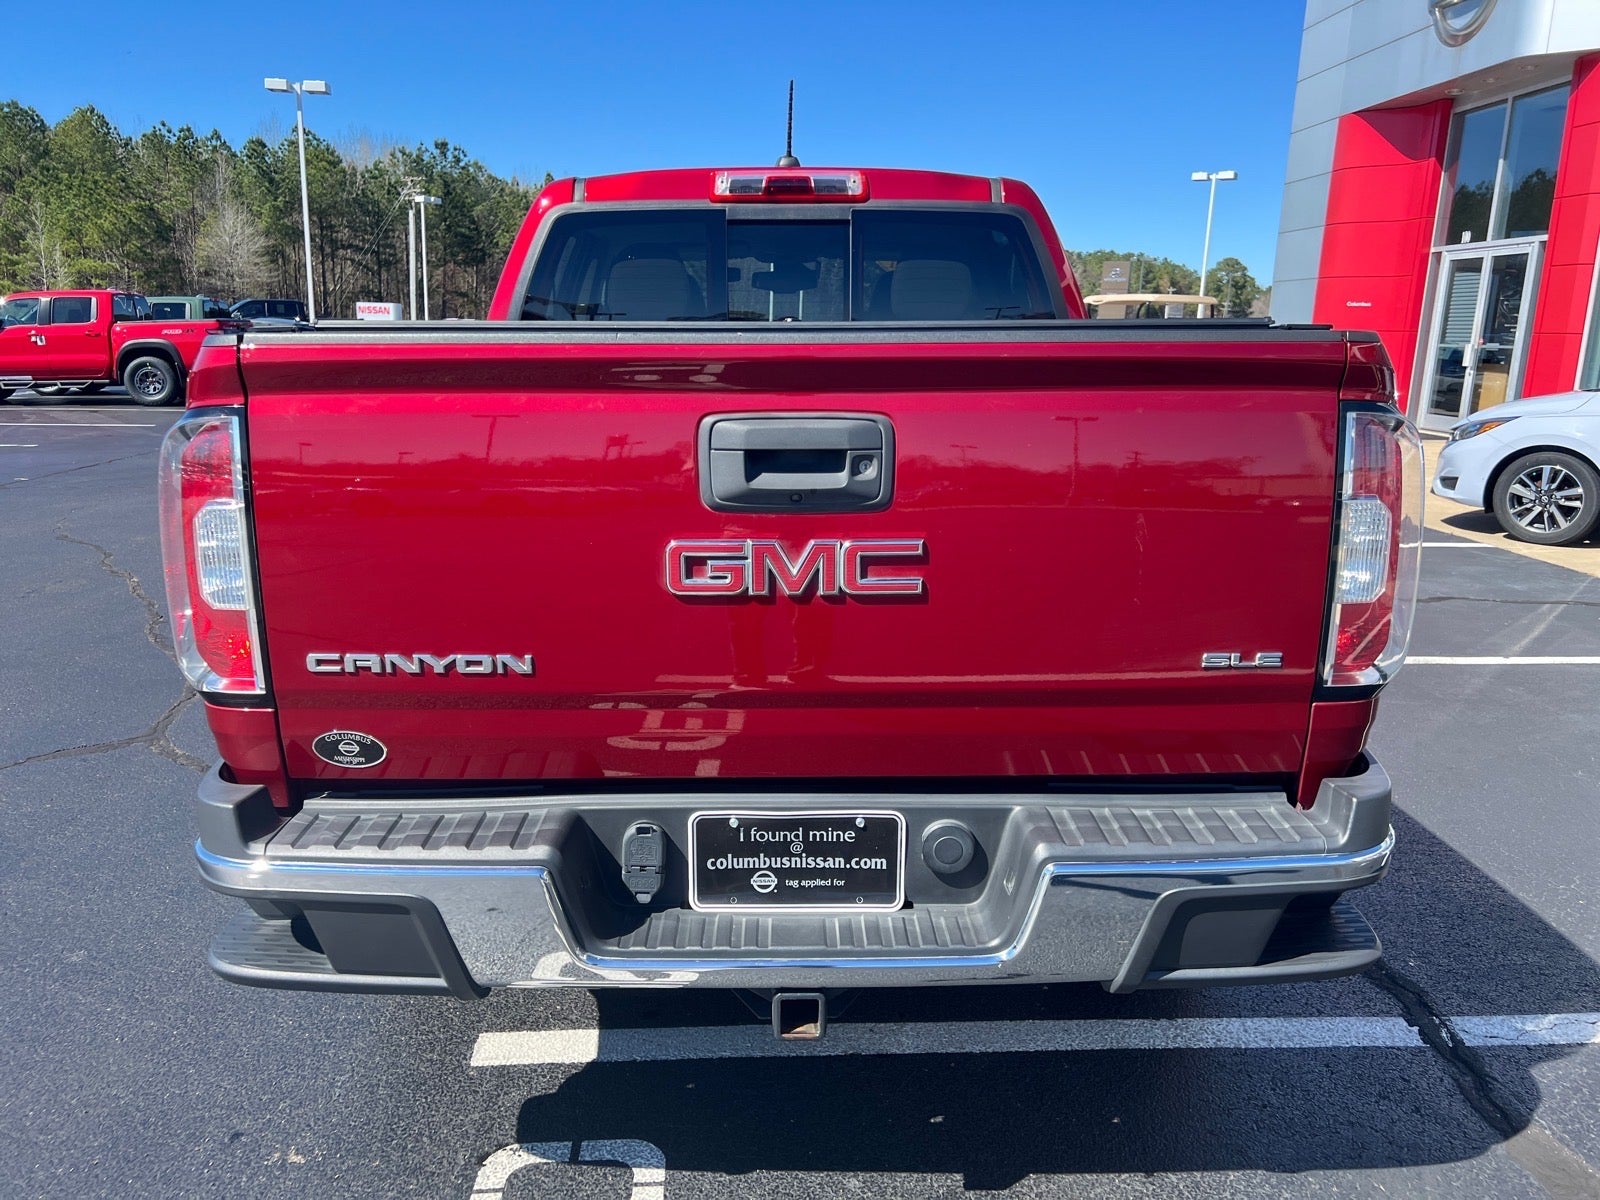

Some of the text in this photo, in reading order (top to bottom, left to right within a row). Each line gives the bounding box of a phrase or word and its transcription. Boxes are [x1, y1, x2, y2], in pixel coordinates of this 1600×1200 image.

[358, 305, 390, 315] NISSAN
[665, 539, 924, 595] GMC
[306, 653, 533, 674] CANYON
[1201, 652, 1283, 668] SLE
[324, 733, 372, 745] COLUMBUS
[750, 826, 803, 842] found
[809, 827, 856, 842] mine
[790, 842, 804, 854] @
[706, 853, 887, 870] columbusnissan.com
[785, 878, 845, 888] tag applied for
